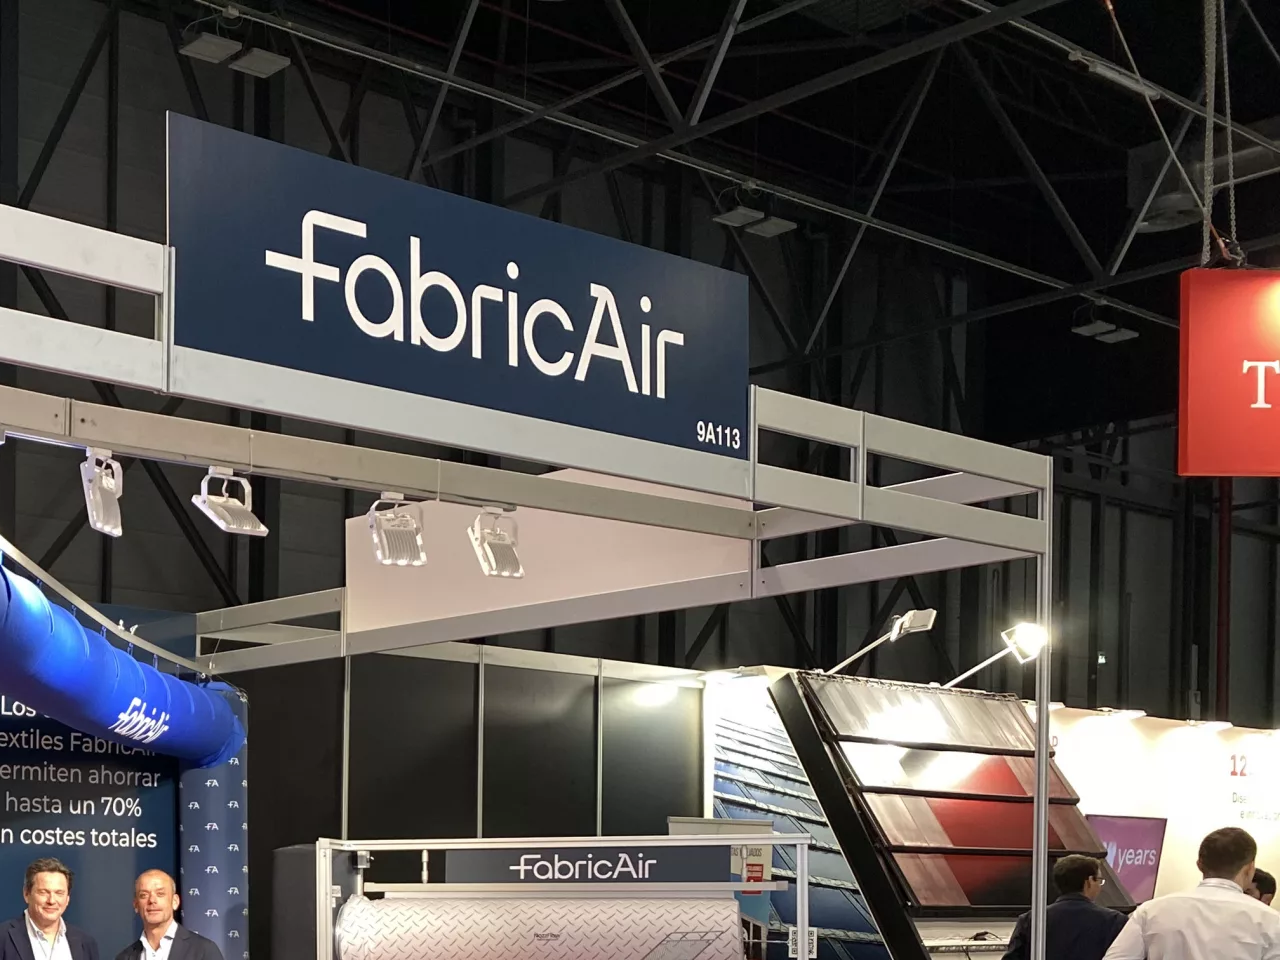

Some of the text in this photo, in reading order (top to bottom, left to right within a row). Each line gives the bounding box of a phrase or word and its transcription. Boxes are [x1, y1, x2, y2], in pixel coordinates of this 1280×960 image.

[266, 209, 684, 399] FabricAir
[696, 420, 741, 450] 9A113
[88, 765, 161, 787] ahorrar
[5, 791, 142, 818] hasta un 70%
[20, 827, 86, 846] costes
[90, 827, 157, 848] totales
[509, 853, 657, 880] FabricAir
[1117, 848, 1157, 872] years
